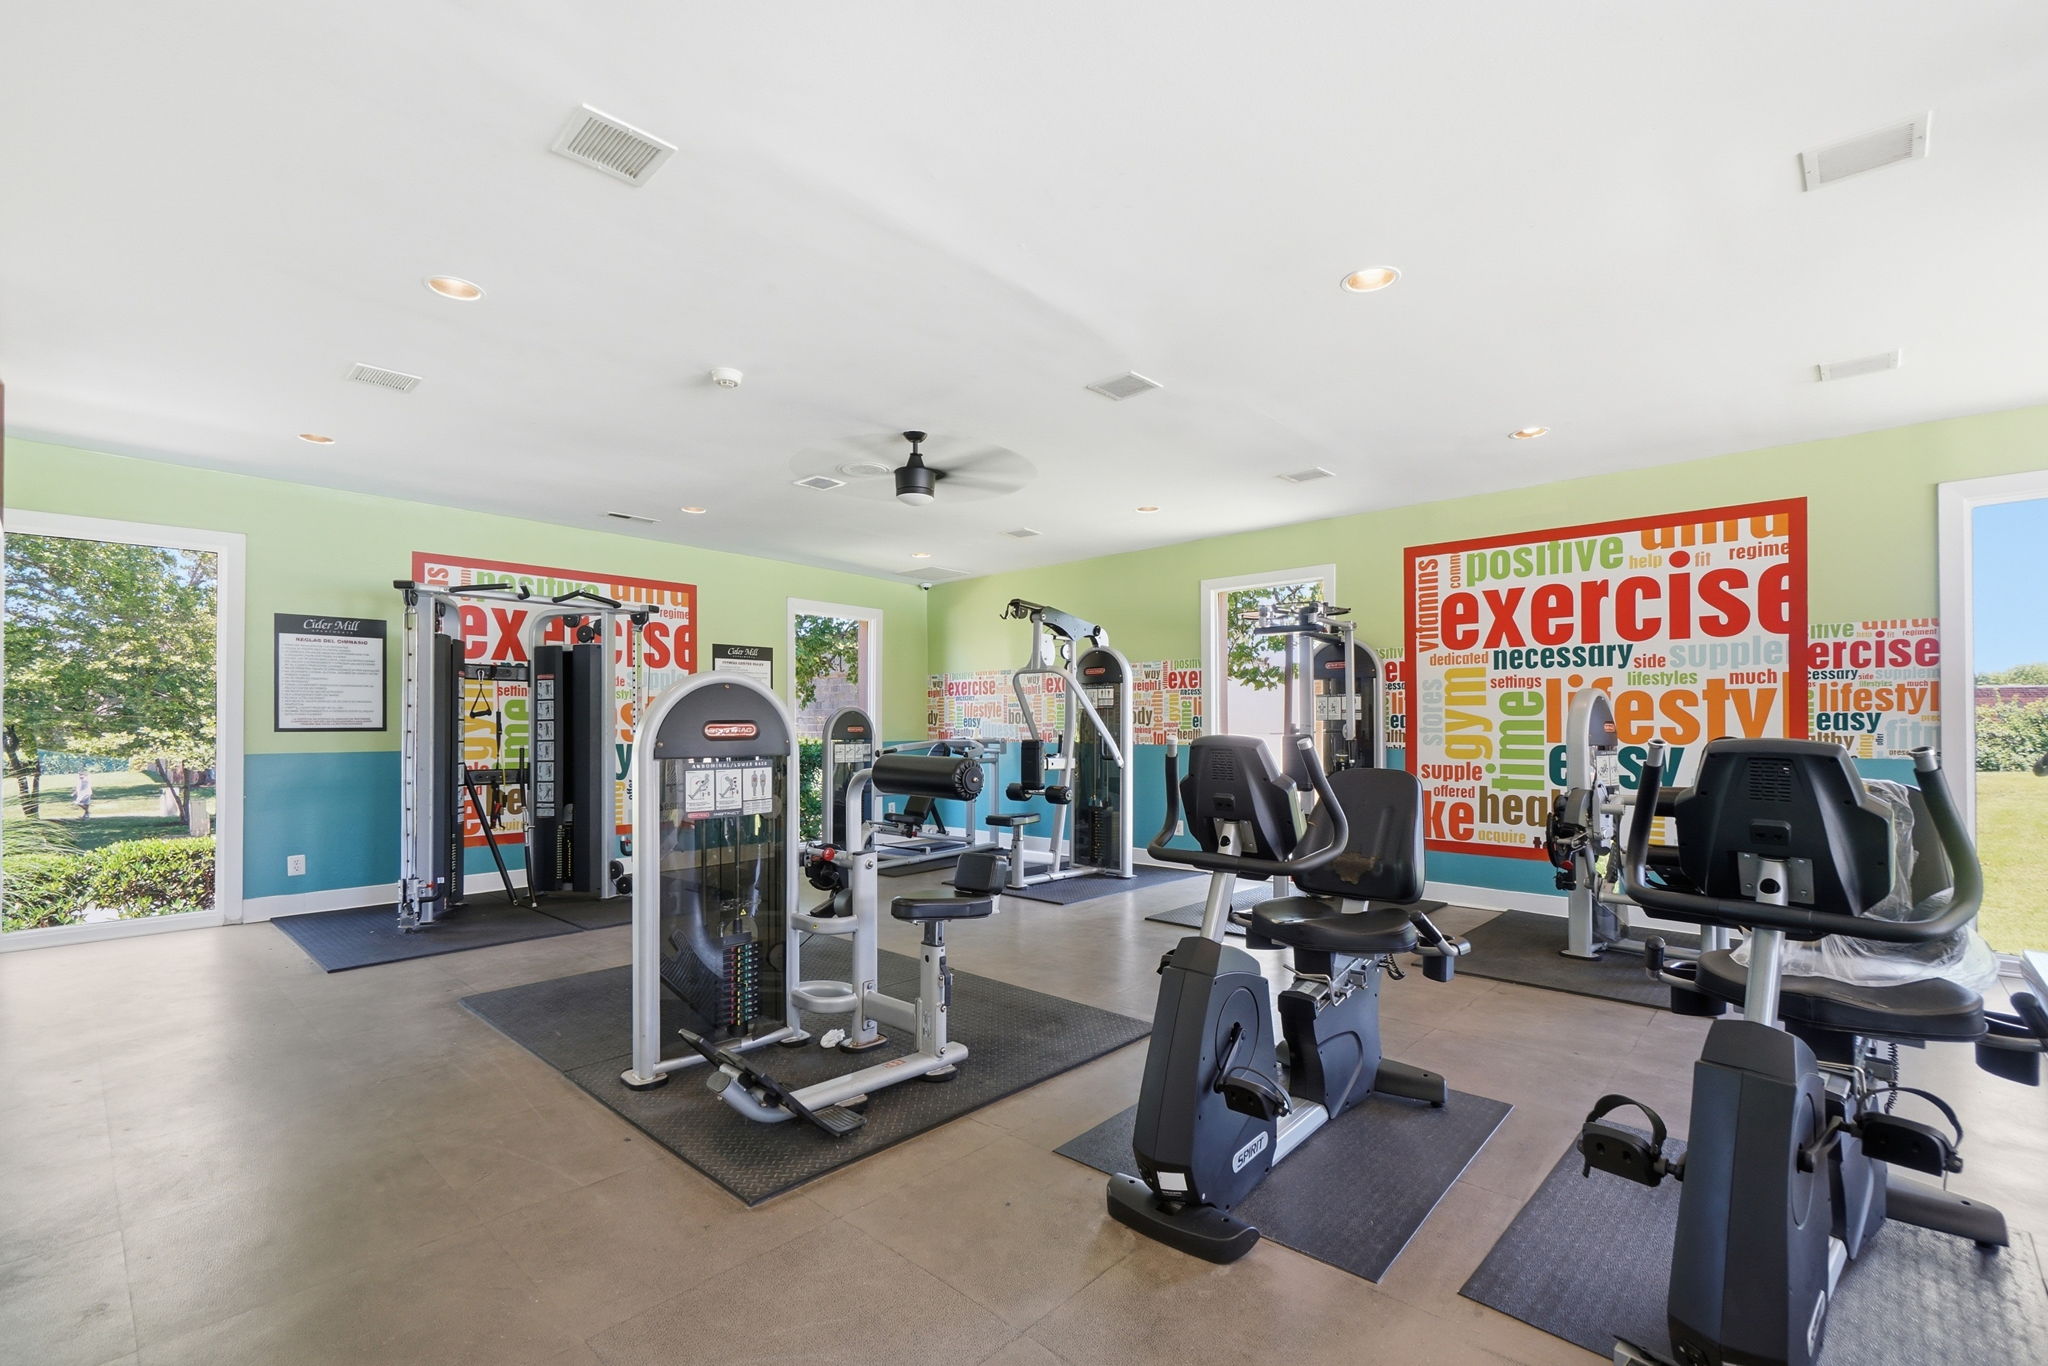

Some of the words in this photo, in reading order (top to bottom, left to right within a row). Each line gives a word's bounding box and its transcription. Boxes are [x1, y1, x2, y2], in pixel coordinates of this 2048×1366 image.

[1467, 536, 1624, 587] positive
[1629, 554, 1663, 570] help
[1694, 551, 1711, 567] fit
[1418, 558, 1439, 653] vitamins
[1441, 550, 1790, 651] exercise
[303, 619, 333, 630] Cider
[334, 620, 361, 632] Mill
[1807, 622, 1855, 640] itive
[727, 647, 744, 656] Cider
[744, 648, 759, 657] Mill
[1429, 651, 1489, 667] dedicated
[1493, 643, 1634, 671] necessary
[1669, 634, 1789, 671] supple
[1808, 630, 1939, 670] ercise
[1633, 653, 1666, 669] side
[1144, 669, 1160, 680] way
[1490, 674, 1542, 690] settings
[1627, 670, 1698, 687] lifestyles
[1729, 668, 1778, 686] much
[1906, 679, 1929, 687] much
[948, 676, 996, 697] exercise
[963, 701, 1002, 719] lifestyle
[1419, 678, 1443, 746] stores
[1444, 666, 1494, 760] gym
[963, 717, 981, 728] easy
[1816, 711, 1882, 734] easy
[1485, 690, 1545, 792] time
[1421, 761, 1483, 783] supple
[1433, 784, 1476, 799] offered
[1478, 828, 1527, 845] acquire
[1237, 1136, 1264, 1169] SPIRIT
